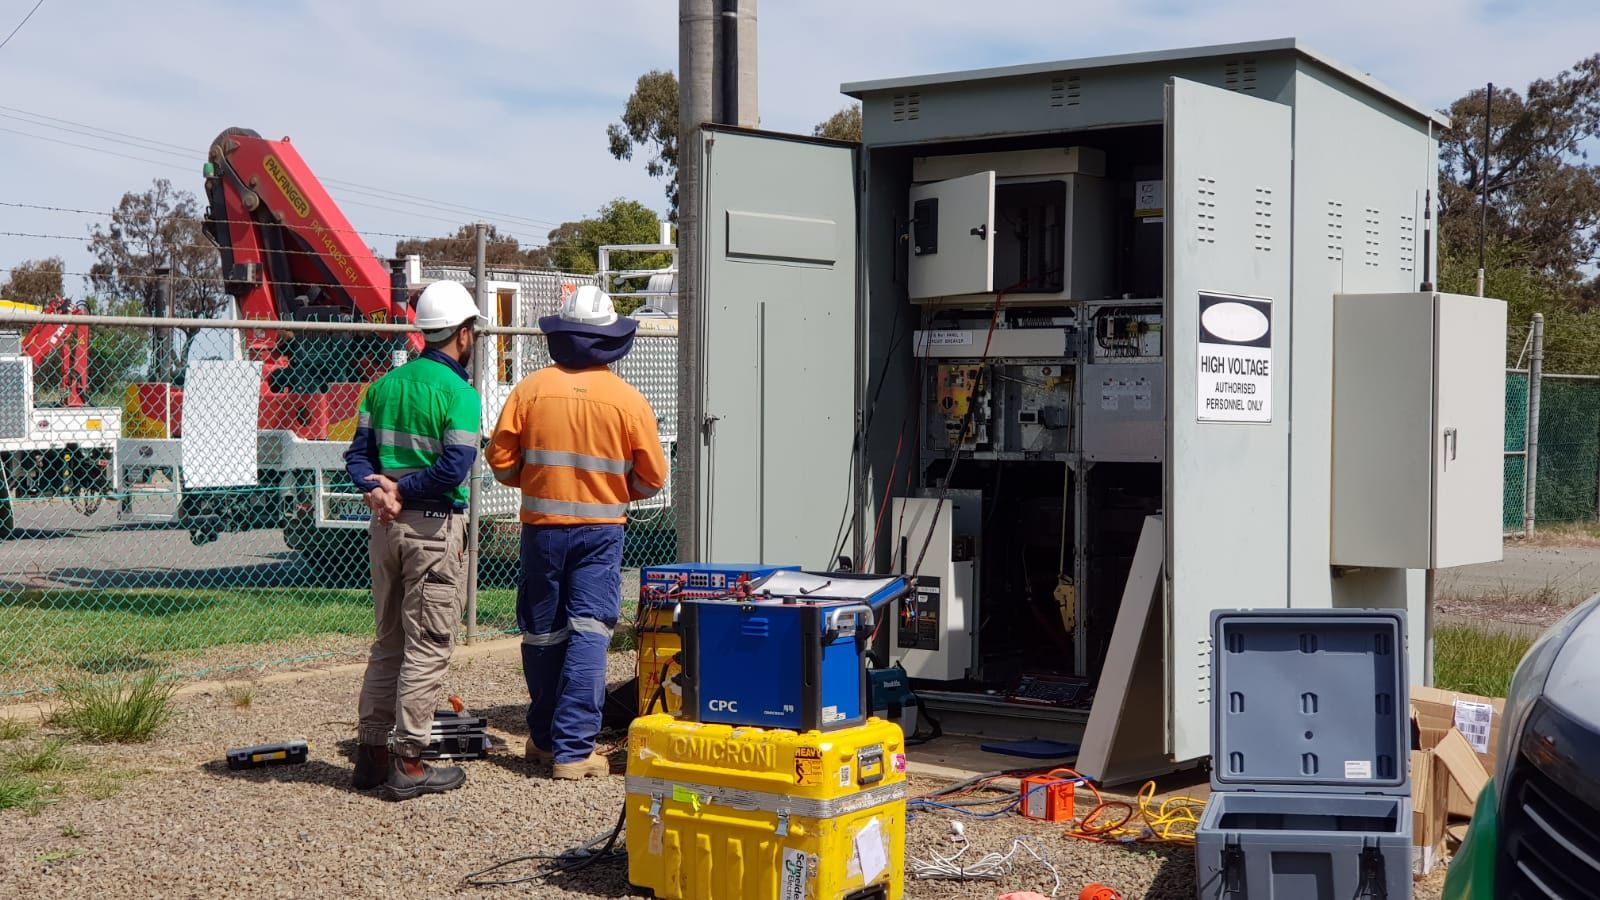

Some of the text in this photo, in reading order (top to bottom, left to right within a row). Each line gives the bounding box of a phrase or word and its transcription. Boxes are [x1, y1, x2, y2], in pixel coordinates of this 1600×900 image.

[265, 158, 307, 215] PALFINGER
[1201, 355, 1269, 376] HIGH VOLTAGE
[1215, 382, 1256, 394] AUTHORISED
[1206, 398, 1263, 411] PERSONNEL ONLY
[708, 700, 738, 713] CPC
[674, 736, 773, 768] OMICRON
[795, 747, 822, 758] HEAVY
